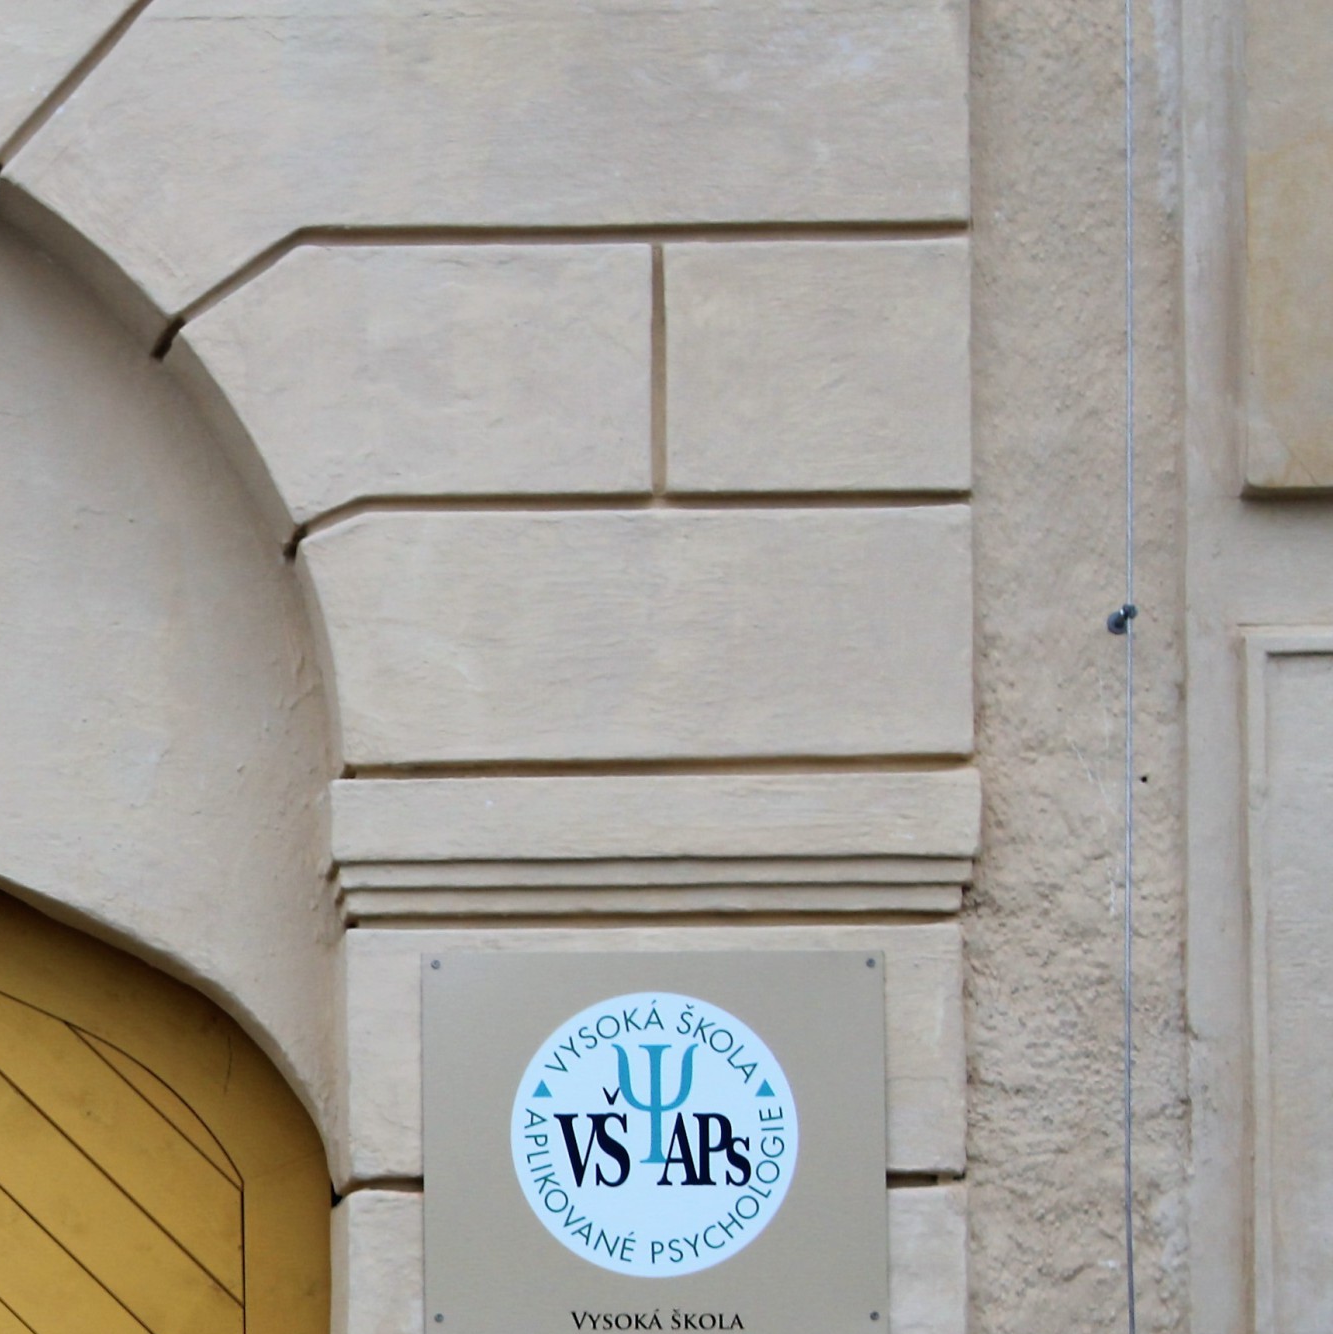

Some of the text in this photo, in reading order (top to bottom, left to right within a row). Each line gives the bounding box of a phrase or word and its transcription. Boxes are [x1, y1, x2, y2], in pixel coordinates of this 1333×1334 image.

[543, 999, 760, 1085] VYSOKÁ ŠKOLA
[524, 1106, 785, 1265] APLIKOVANÉ PSYCHOLOGIE
[570, 1309, 745, 1331] VYSOKÁ ŠKOLA
